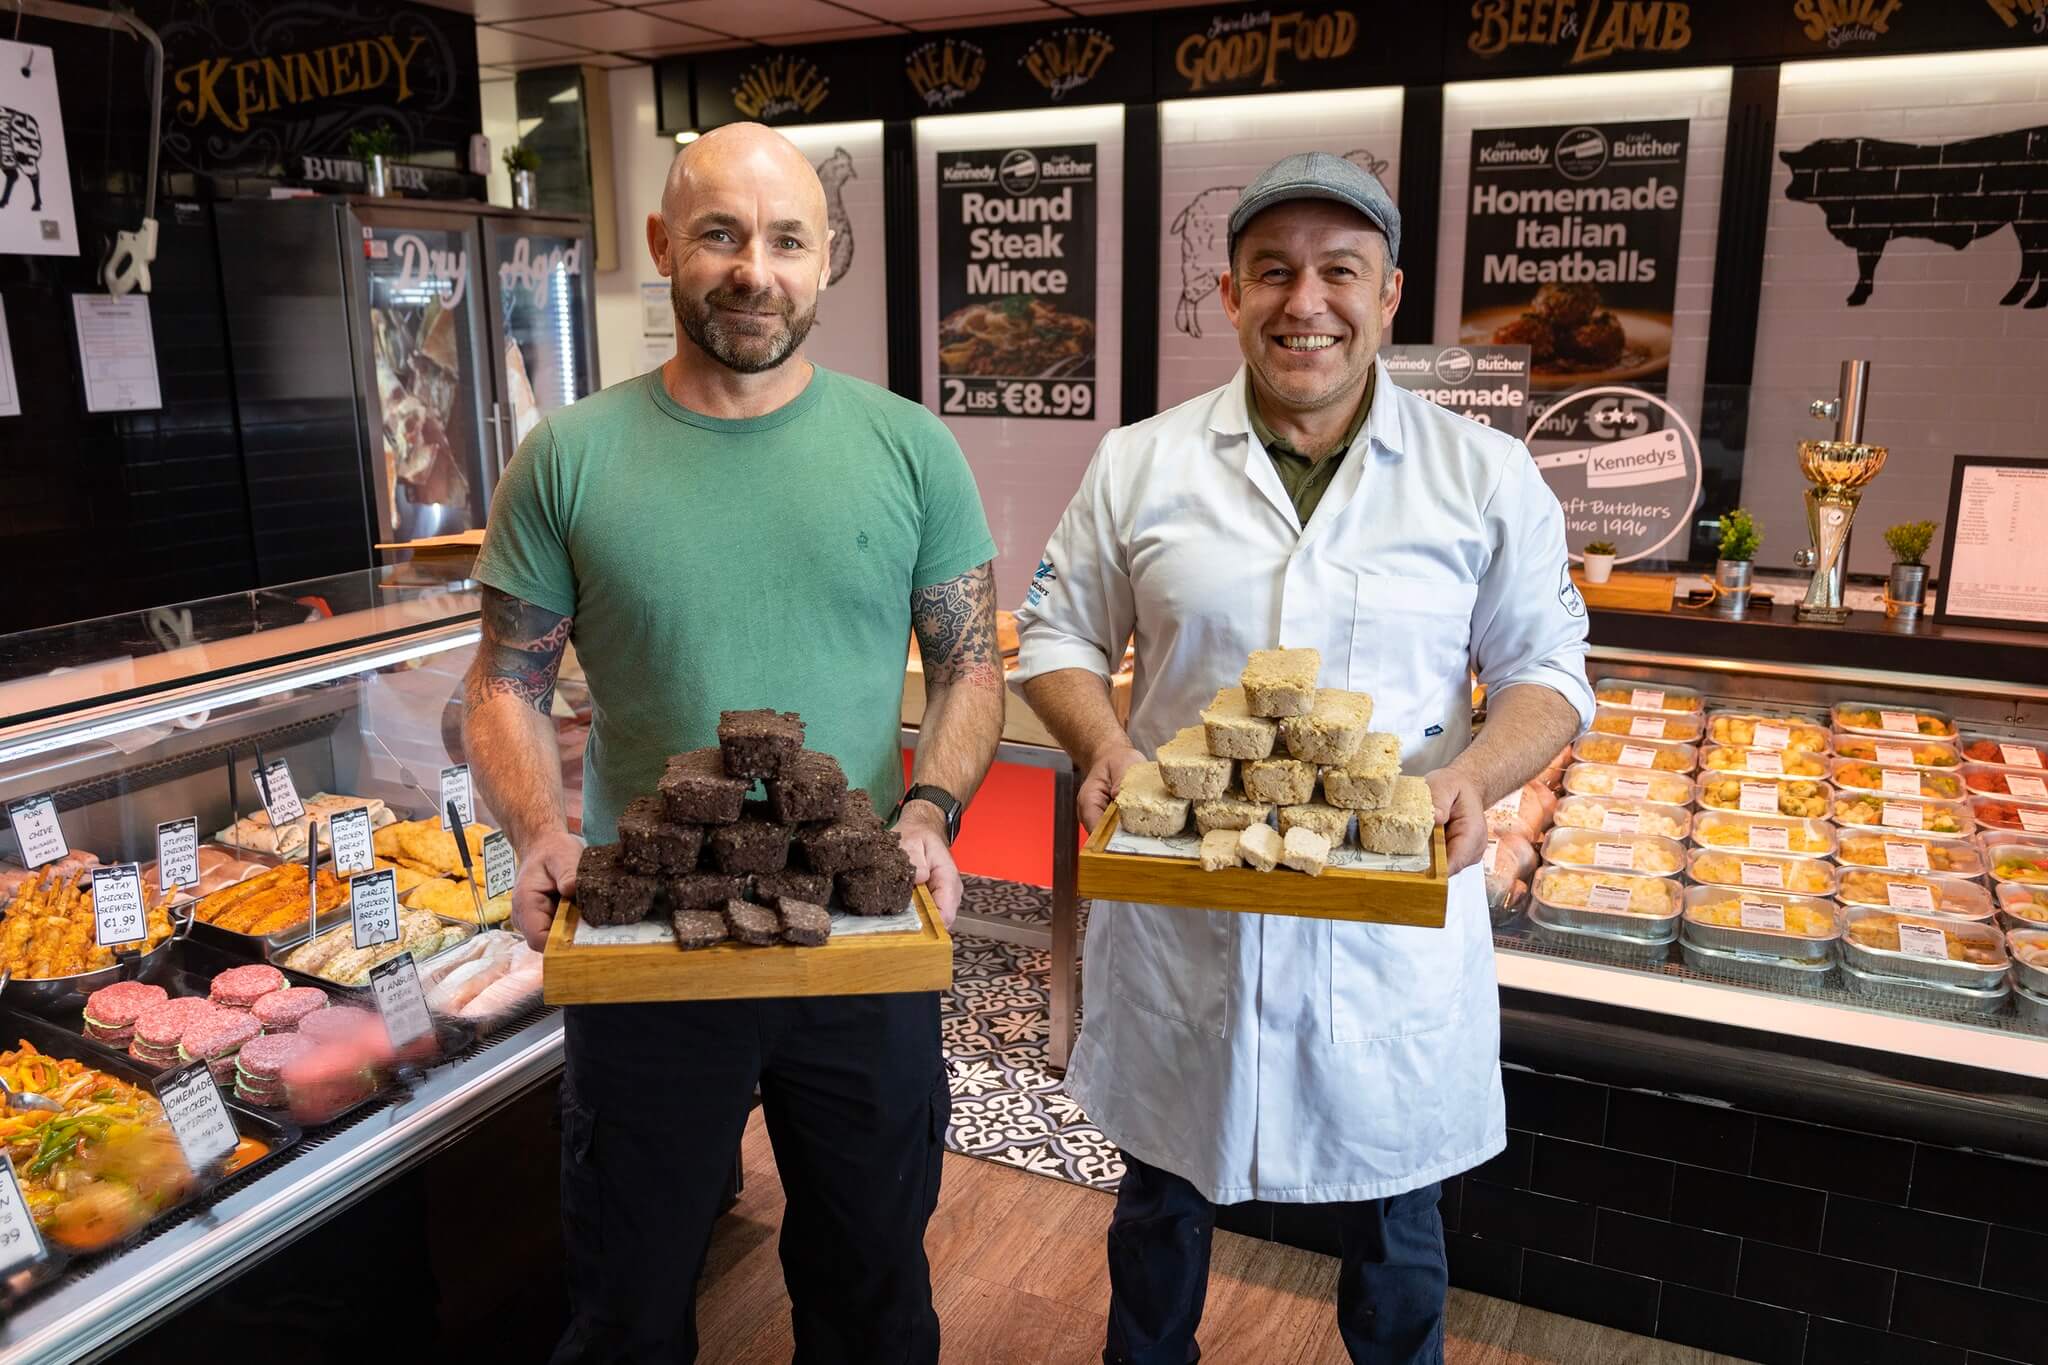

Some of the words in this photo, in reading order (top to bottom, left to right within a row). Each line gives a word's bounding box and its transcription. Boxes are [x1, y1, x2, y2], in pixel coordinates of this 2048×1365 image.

[1468, 0, 1577, 57] BEEF
[1569, 0, 1691, 64] LAMB
[1175, 31, 1265, 91] GOOD
[1261, 10, 1358, 87] FOOD
[905, 40, 987, 97] MEALS
[174, 34, 427, 133] KENNEDY
[1479, 144, 1549, 165] Kennedy
[1612, 140, 1681, 158] Butcher
[302, 154, 429, 192] BUTER
[943, 164, 997, 182] Kennedy
[1041, 159, 1093, 177] Butcher
[961, 187, 1073, 225] Round
[1472, 177, 1679, 215] Homemade
[969, 224, 1064, 260] Steak
[1515, 216, 1627, 249] Italian
[393, 234, 468, 309] Dry
[1482, 250, 1657, 284] Meatballs
[966, 262, 1068, 295] Mince
[1382, 358, 1431, 373] Kennedy
[1476, 356, 1525, 372] Butcher
[943, 379, 967, 413] 2
[967, 391, 998, 409] LBS
[1001, 383, 1092, 416] €8.99
[1412, 384, 1524, 407] memade
[1593, 449, 1677, 472] Kennedys
[1561, 497, 1588, 515] aft
[1589, 499, 1672, 519] Butchers
[1567, 516, 1598, 532] ince
[1603, 518, 1648, 536] 1996
[23, 808, 44, 821] PORK
[28, 825, 54, 840] CHIVE
[339, 850, 365, 864] €2.99
[166, 863, 192, 878] €2.99
[103, 881, 131, 892] SATAY
[360, 886, 389, 899] GARLIC
[98, 891, 134, 904] CHICKEN
[356, 897, 390, 911] CHICKEN
[98, 902, 137, 915] SKEWERS
[359, 907, 389, 920] BREAST
[104, 914, 136, 928] €1.99
[173, 1092, 213, 1123] CHICKEN
